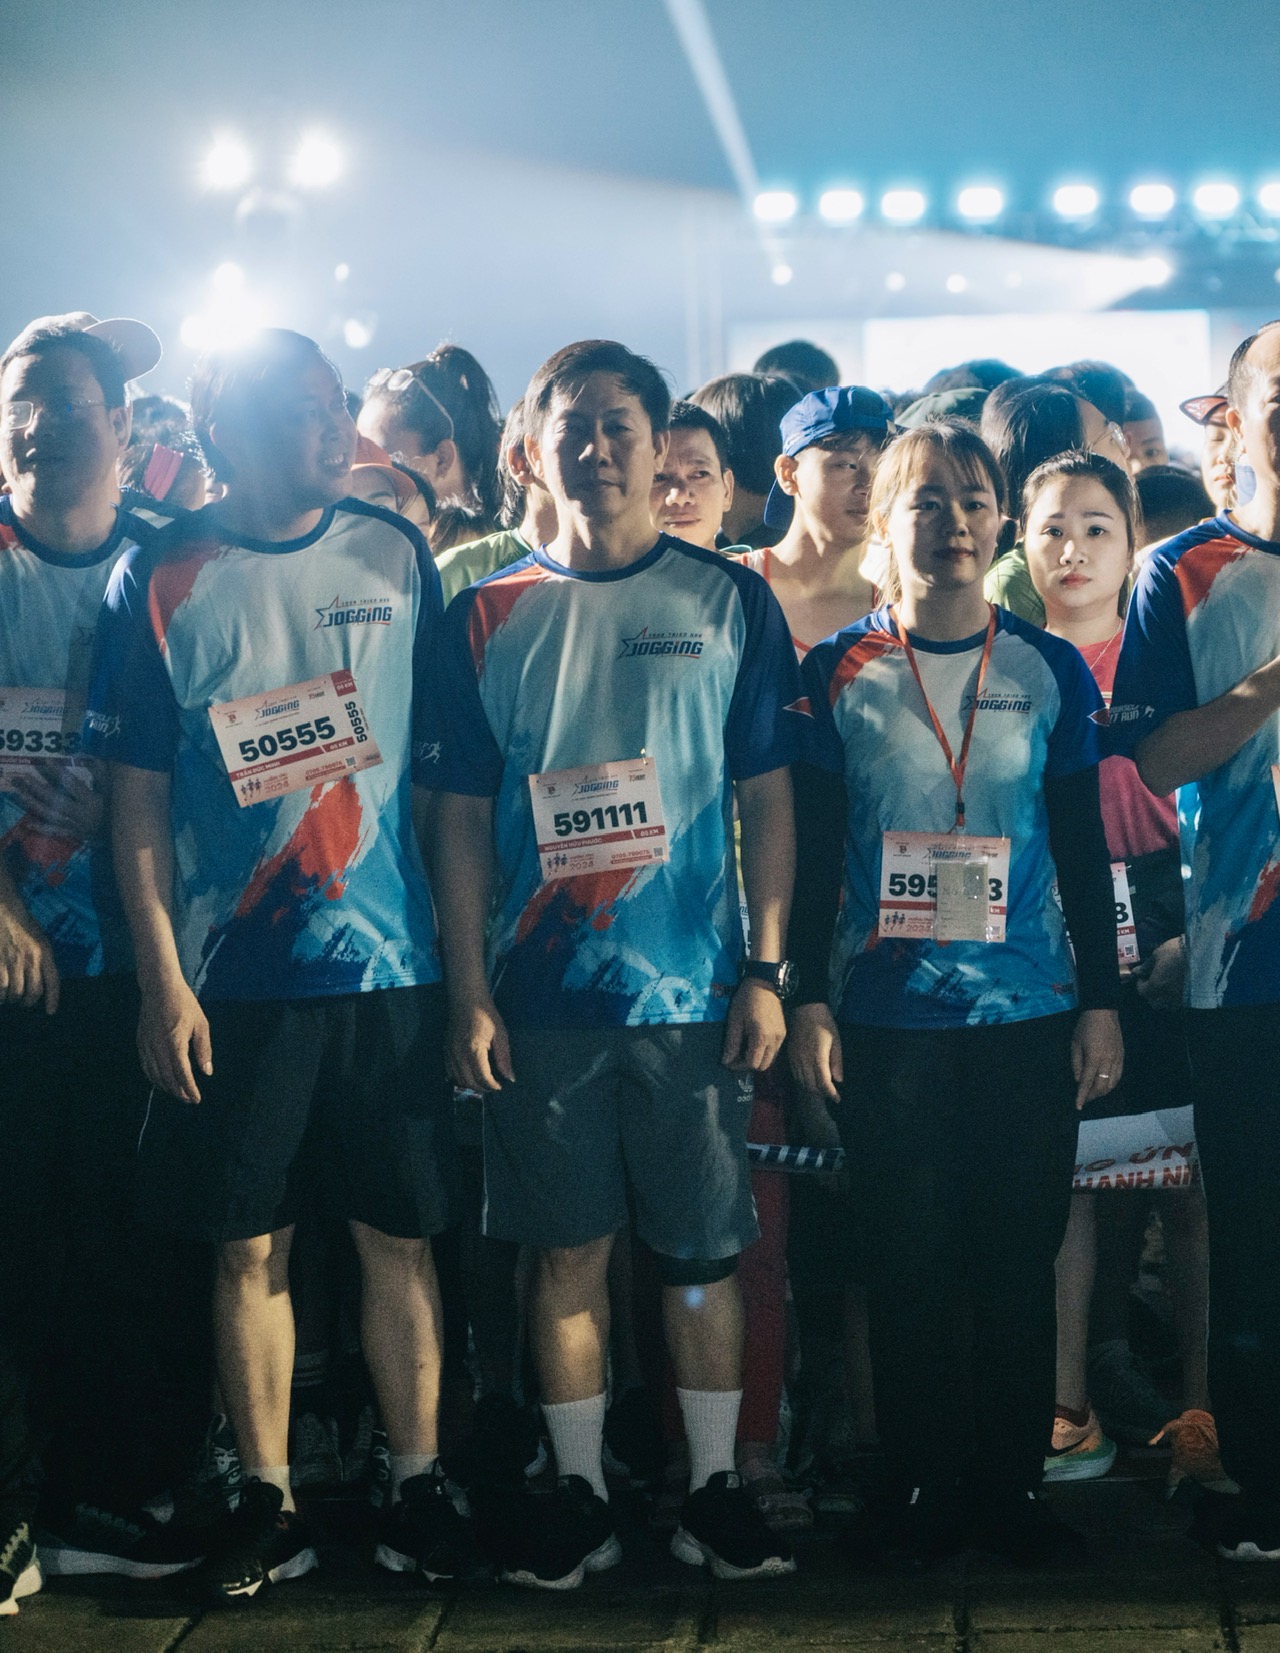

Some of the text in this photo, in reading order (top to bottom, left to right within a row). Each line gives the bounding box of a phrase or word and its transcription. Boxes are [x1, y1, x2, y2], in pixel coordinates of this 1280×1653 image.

[238, 716, 336, 763] 50555
[344, 701, 368, 743] 50555
[554, 801, 648, 837] 591111
[888, 873, 1003, 901] 5953
[1115, 902, 1129, 923] 8
